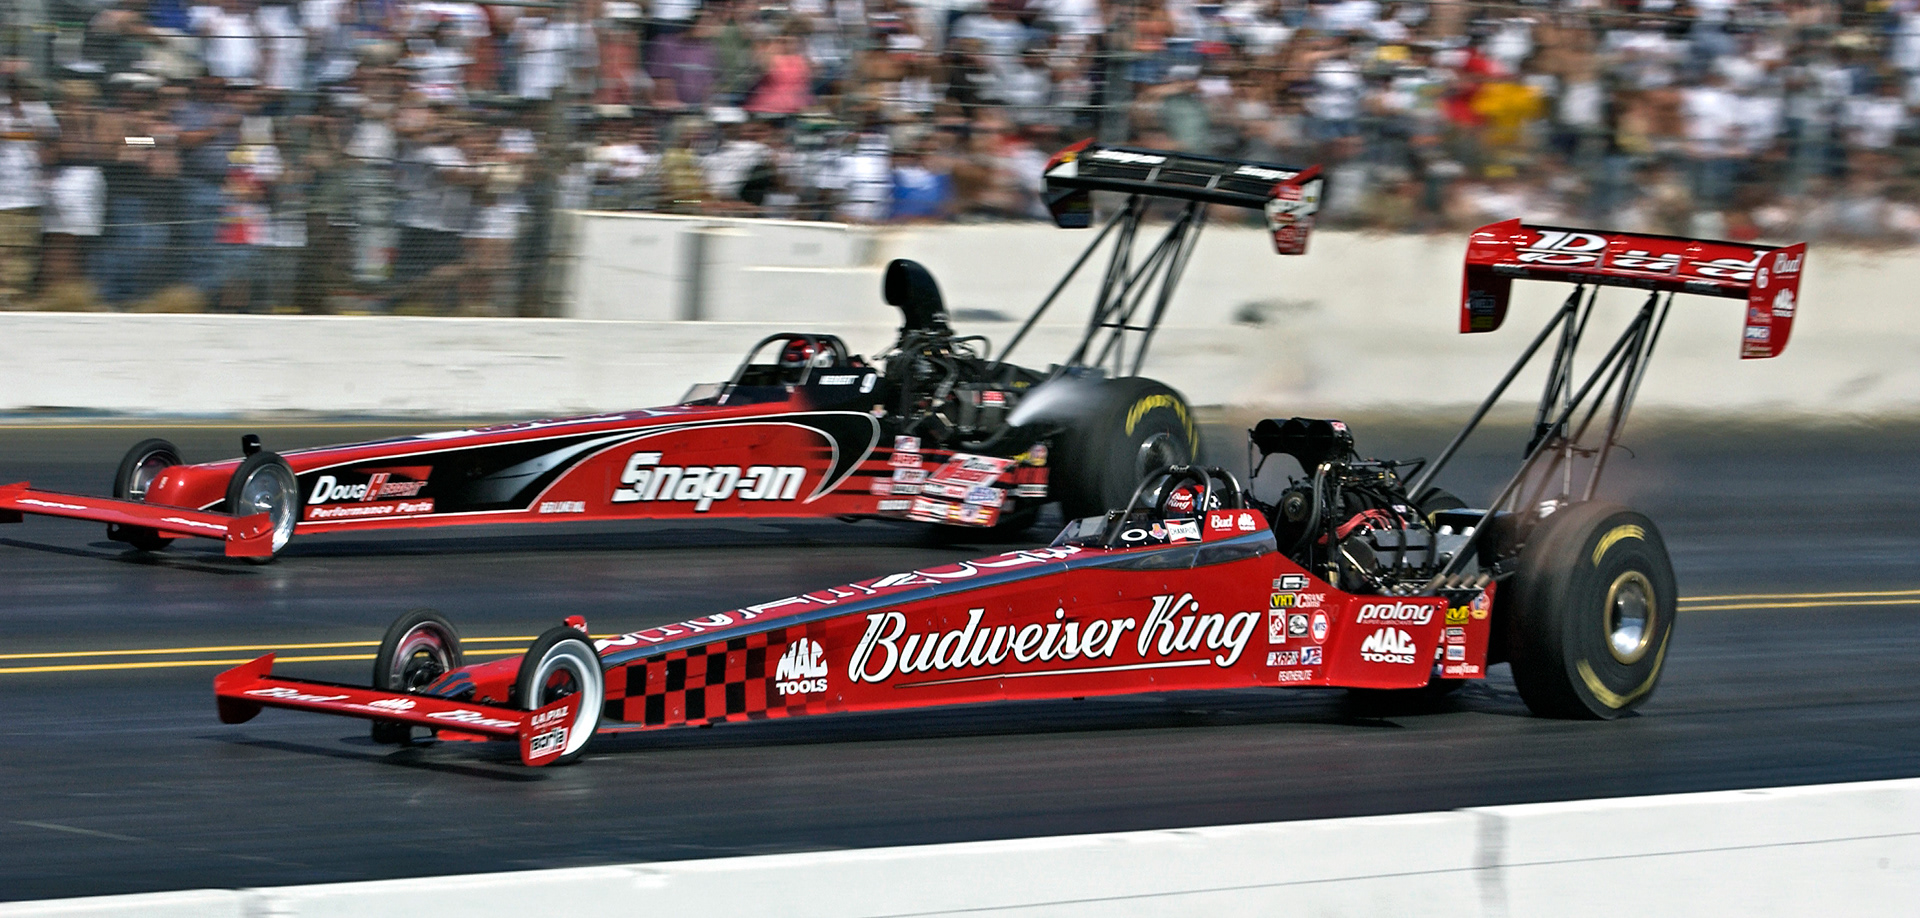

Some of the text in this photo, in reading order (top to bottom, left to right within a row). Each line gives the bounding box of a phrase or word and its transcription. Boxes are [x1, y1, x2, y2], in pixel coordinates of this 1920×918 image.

[1772, 253, 1803, 274] Bud
[1756, 267, 1769, 289] 6
[859, 373, 877, 393] 9
[611, 451, 807, 512] Snap-on
[309, 502, 433, 518] Performance Parts
[1211, 514, 1233, 528] Bud
[1273, 594, 1294, 606] VHT
[1356, 601, 1434, 625] prolong
[848, 608, 1136, 683] Budweiser
[1137, 593, 1261, 668] King
[1361, 627, 1416, 654] MAC
[776, 637, 828, 681] MAC
[1361, 653, 1415, 664] TOOLS
[776, 679, 827, 695] TOOLS
